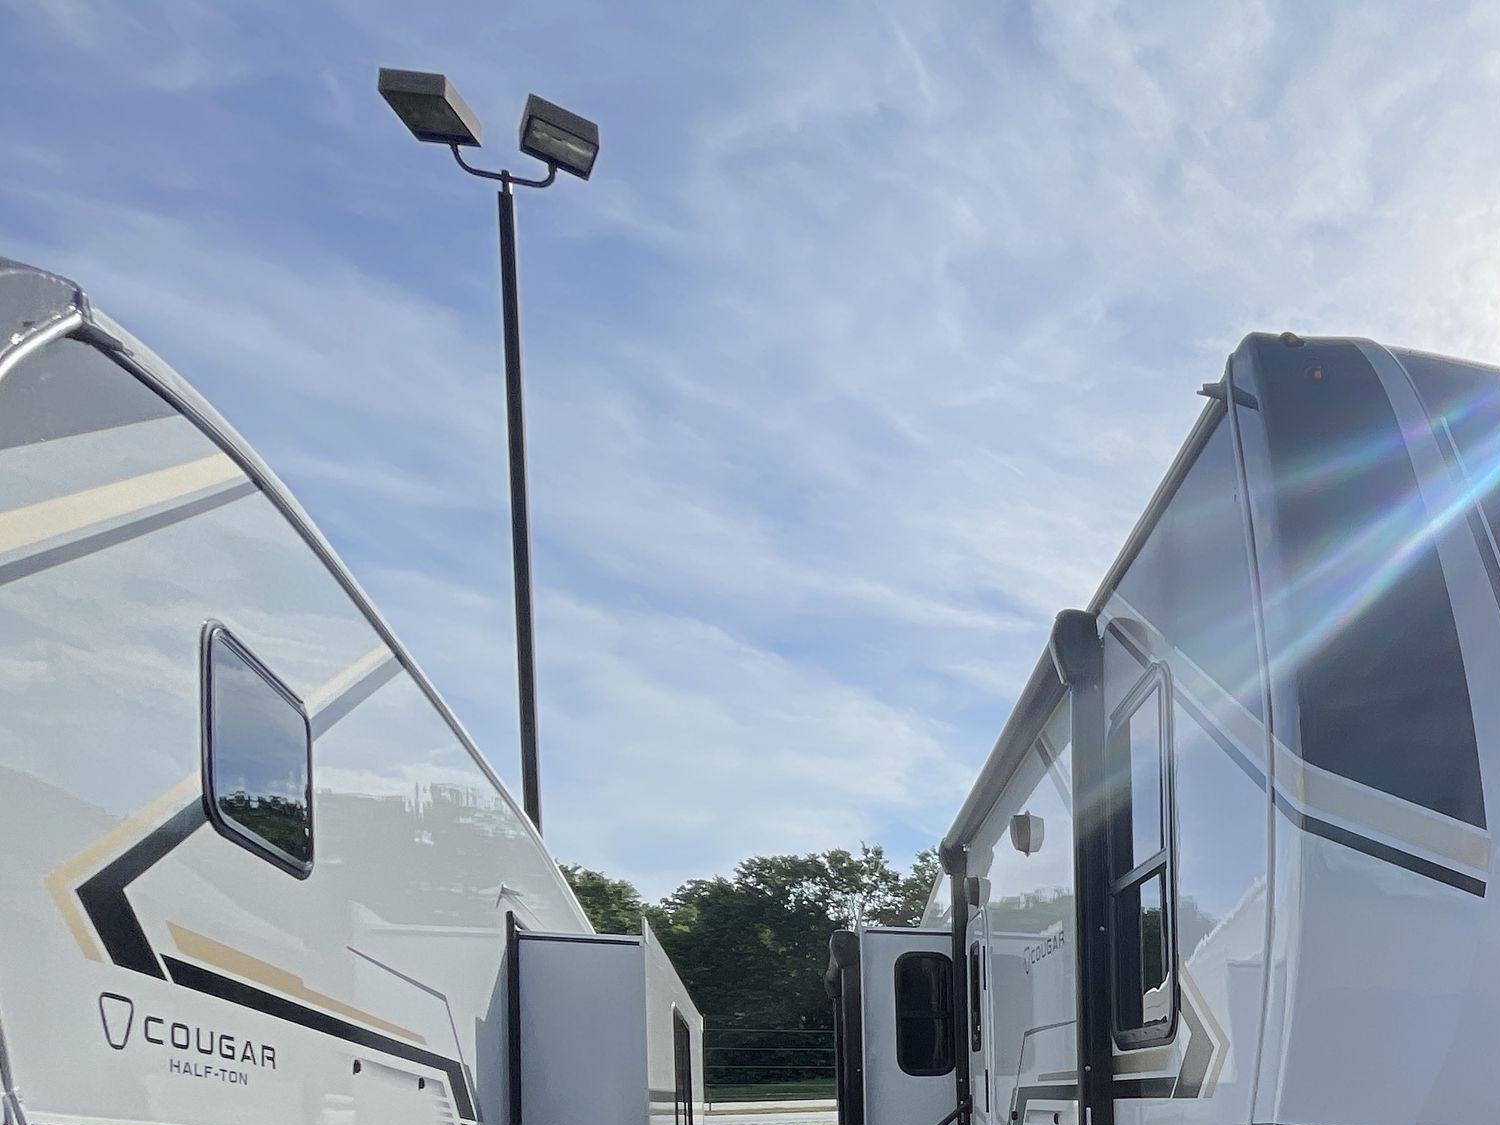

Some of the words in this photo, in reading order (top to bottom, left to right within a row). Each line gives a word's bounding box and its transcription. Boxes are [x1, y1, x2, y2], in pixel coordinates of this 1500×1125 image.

[1031, 930, 1065, 964] COUGAR
[144, 1016, 277, 1069] COUGAR
[169, 1058, 248, 1085] HALF-TON
